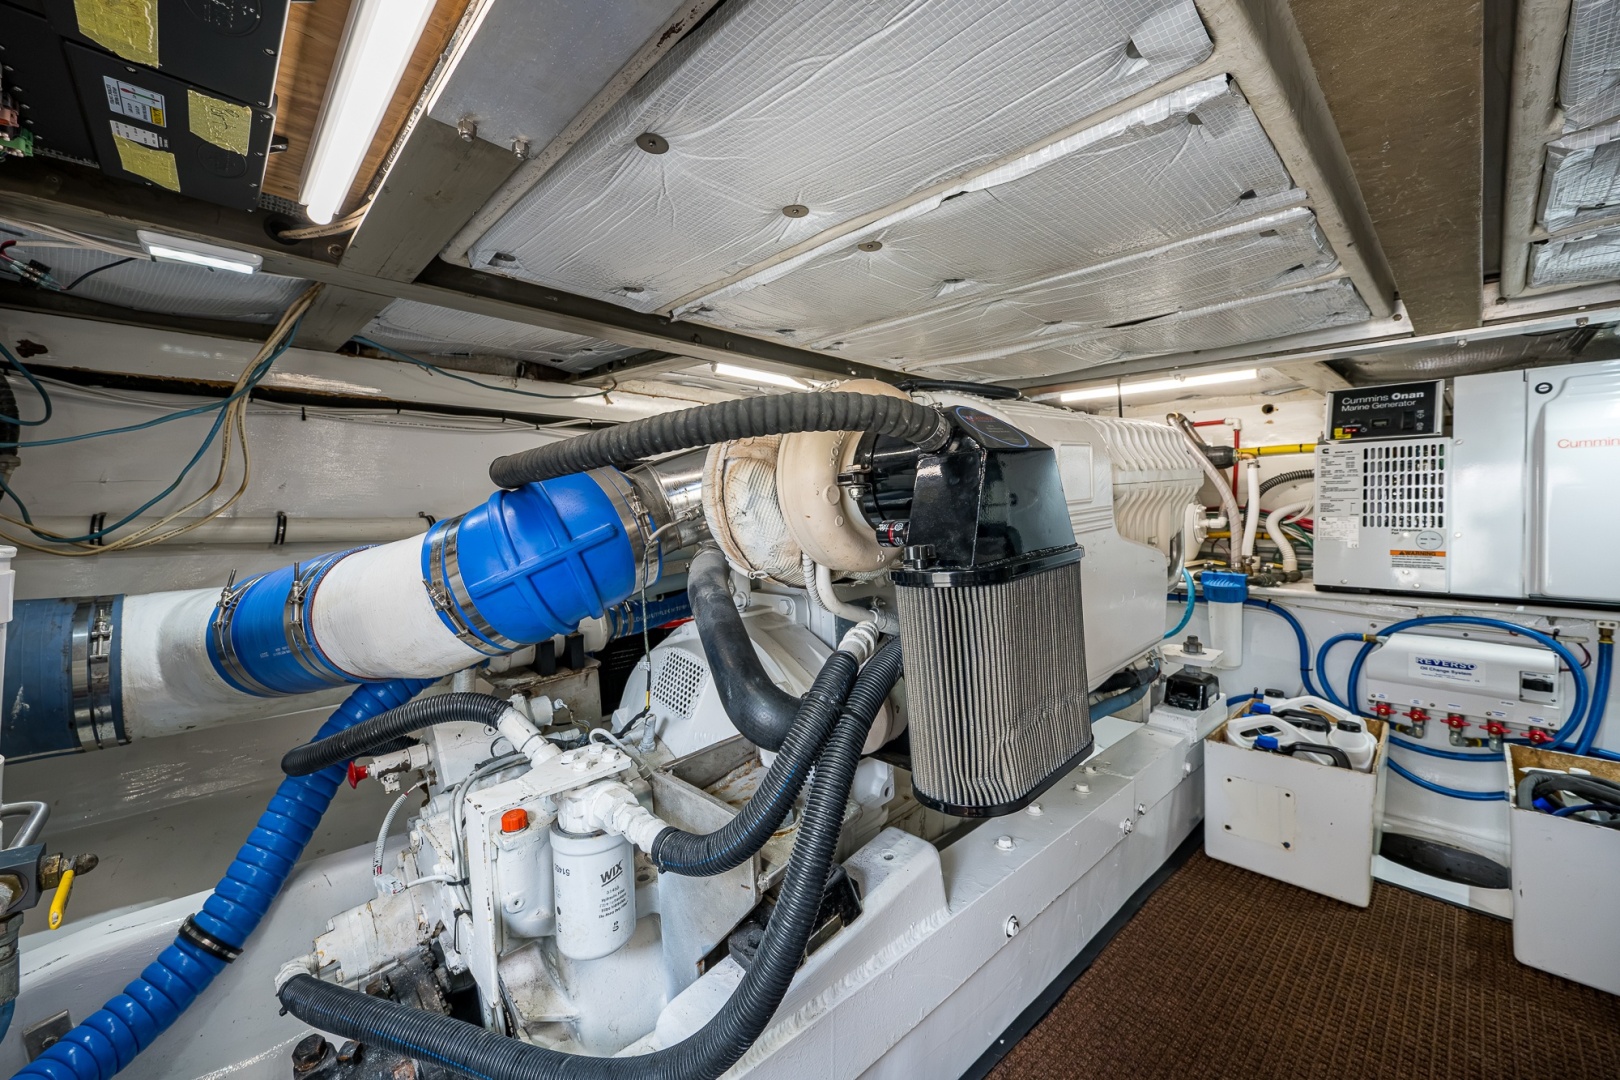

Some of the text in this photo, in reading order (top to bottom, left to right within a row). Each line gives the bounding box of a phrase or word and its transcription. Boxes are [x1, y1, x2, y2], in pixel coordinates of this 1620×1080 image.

[1342, 392, 1425, 405] Cummins Onan
[1372, 400, 1416, 409] Generator
[1415, 657, 1477, 670] REVERSO
[600, 859, 623, 884] WIX
